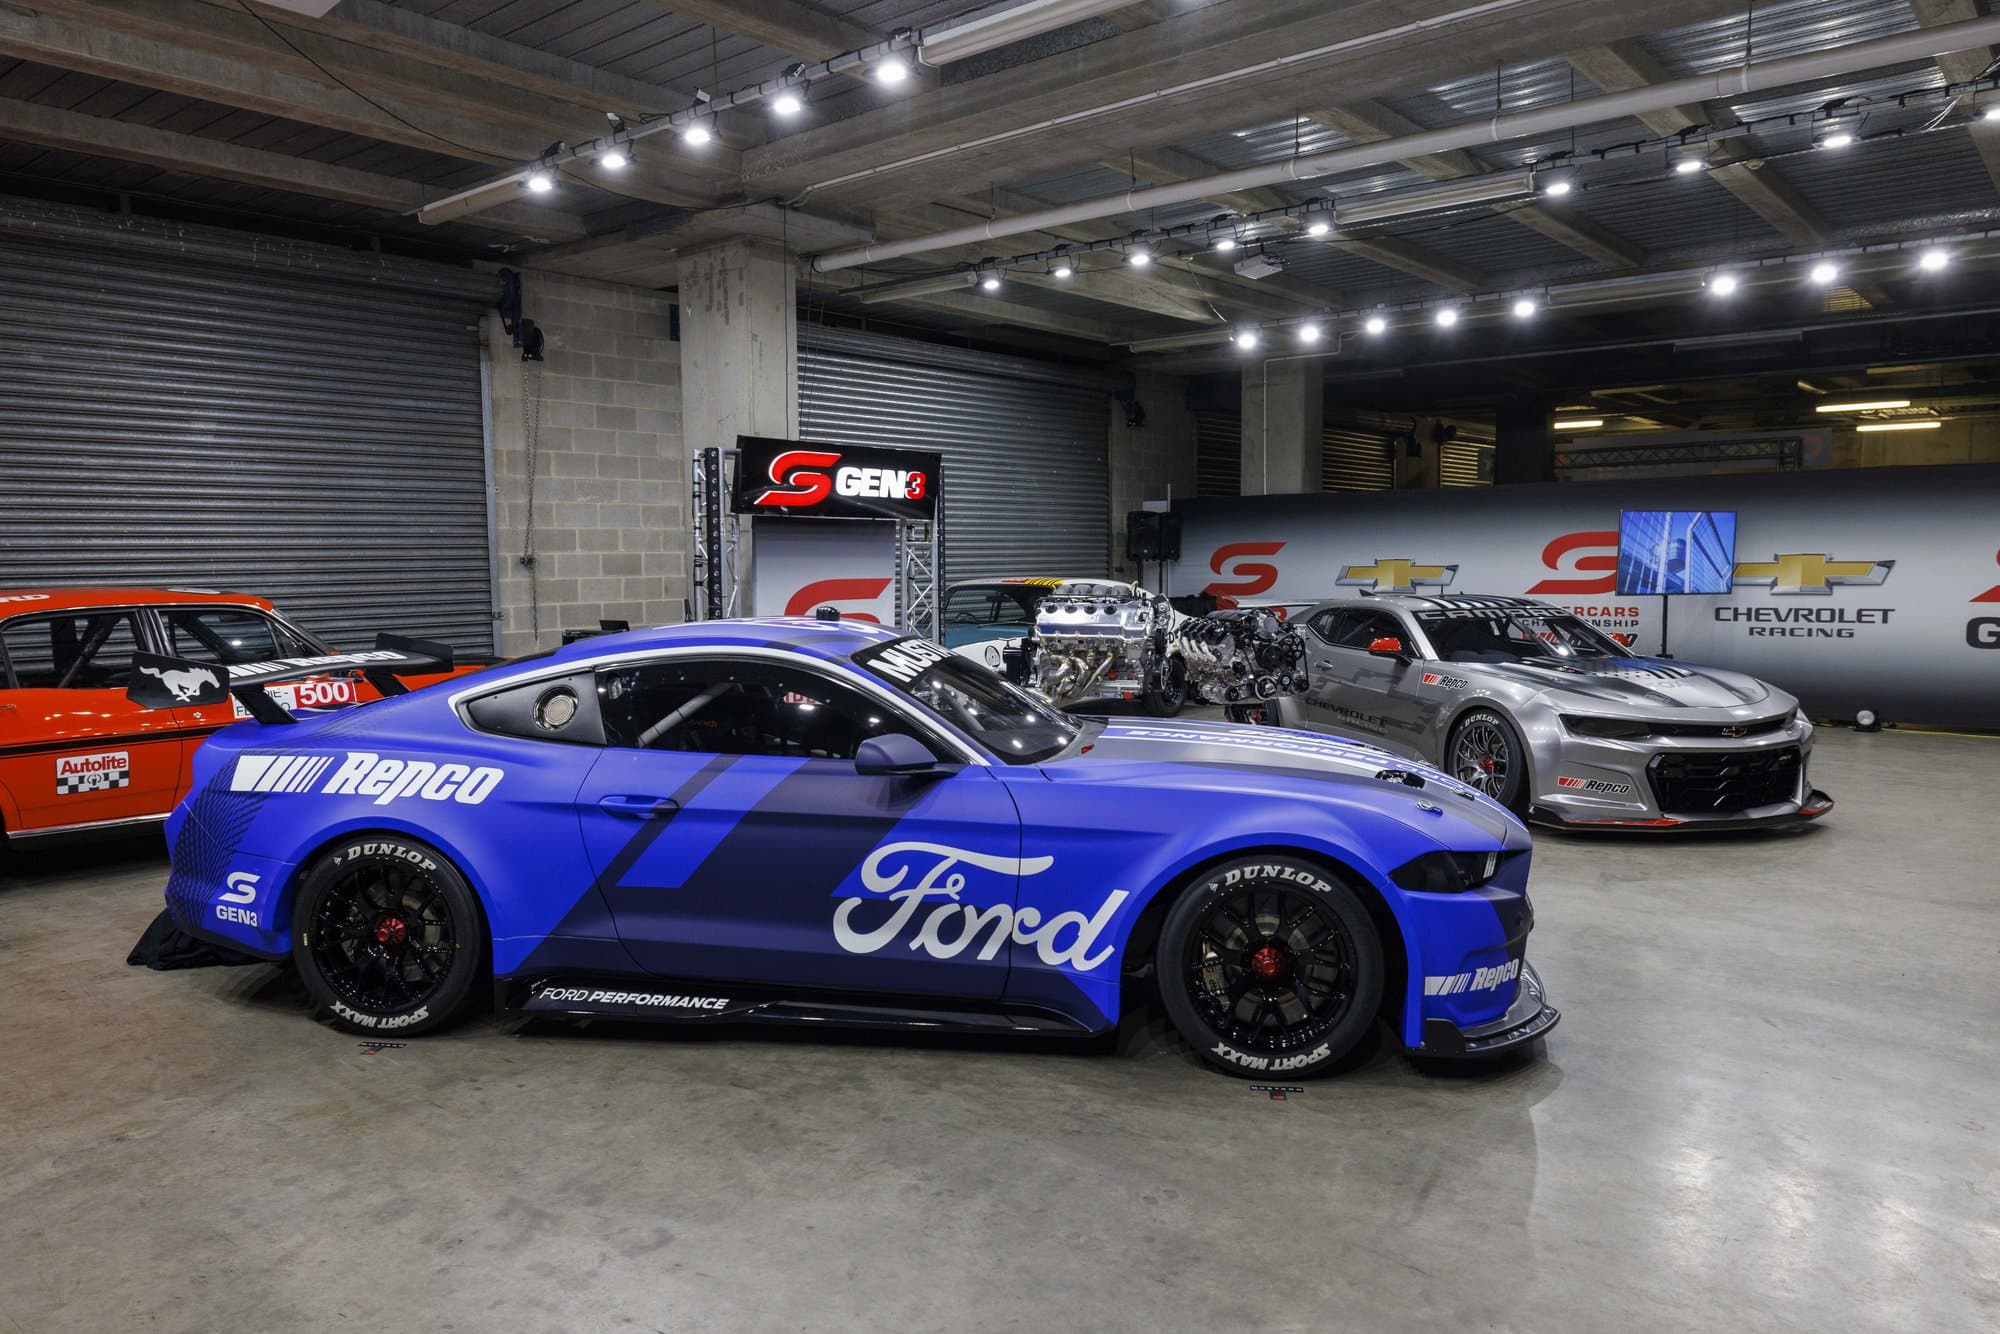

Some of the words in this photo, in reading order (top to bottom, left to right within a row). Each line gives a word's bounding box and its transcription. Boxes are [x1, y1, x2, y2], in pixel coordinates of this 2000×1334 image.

[835, 466, 927, 499] GEN3
[1418, 608, 1571, 622] CAMARO
[1714, 607, 1896, 624] CHEVROLET
[1748, 626, 1855, 638] RACING
[273, 651, 408, 668] Repco
[300, 682, 350, 705] 500
[1440, 675, 1470, 689] Repco
[1464, 713, 1500, 727] DUNLOP
[60, 755, 127, 776] Autolite
[320, 752, 504, 805] Repco
[1584, 778, 1631, 794] Repco
[347, 843, 437, 872] DUNLOP
[1224, 865, 1332, 894] DUNLOP
[215, 905, 258, 927] GEN3
[833, 841, 1130, 971] Ford
[1470, 960, 1519, 992] Repco
[539, 987, 589, 1001] FORD
[588, 991, 730, 1010] PERFORMANCE
[329, 1001, 378, 1028] MAXX
[378, 1005, 430, 1029] SPORT
[1210, 1041, 1274, 1071] MAXX
[1270, 1042, 1332, 1072] SPORT
